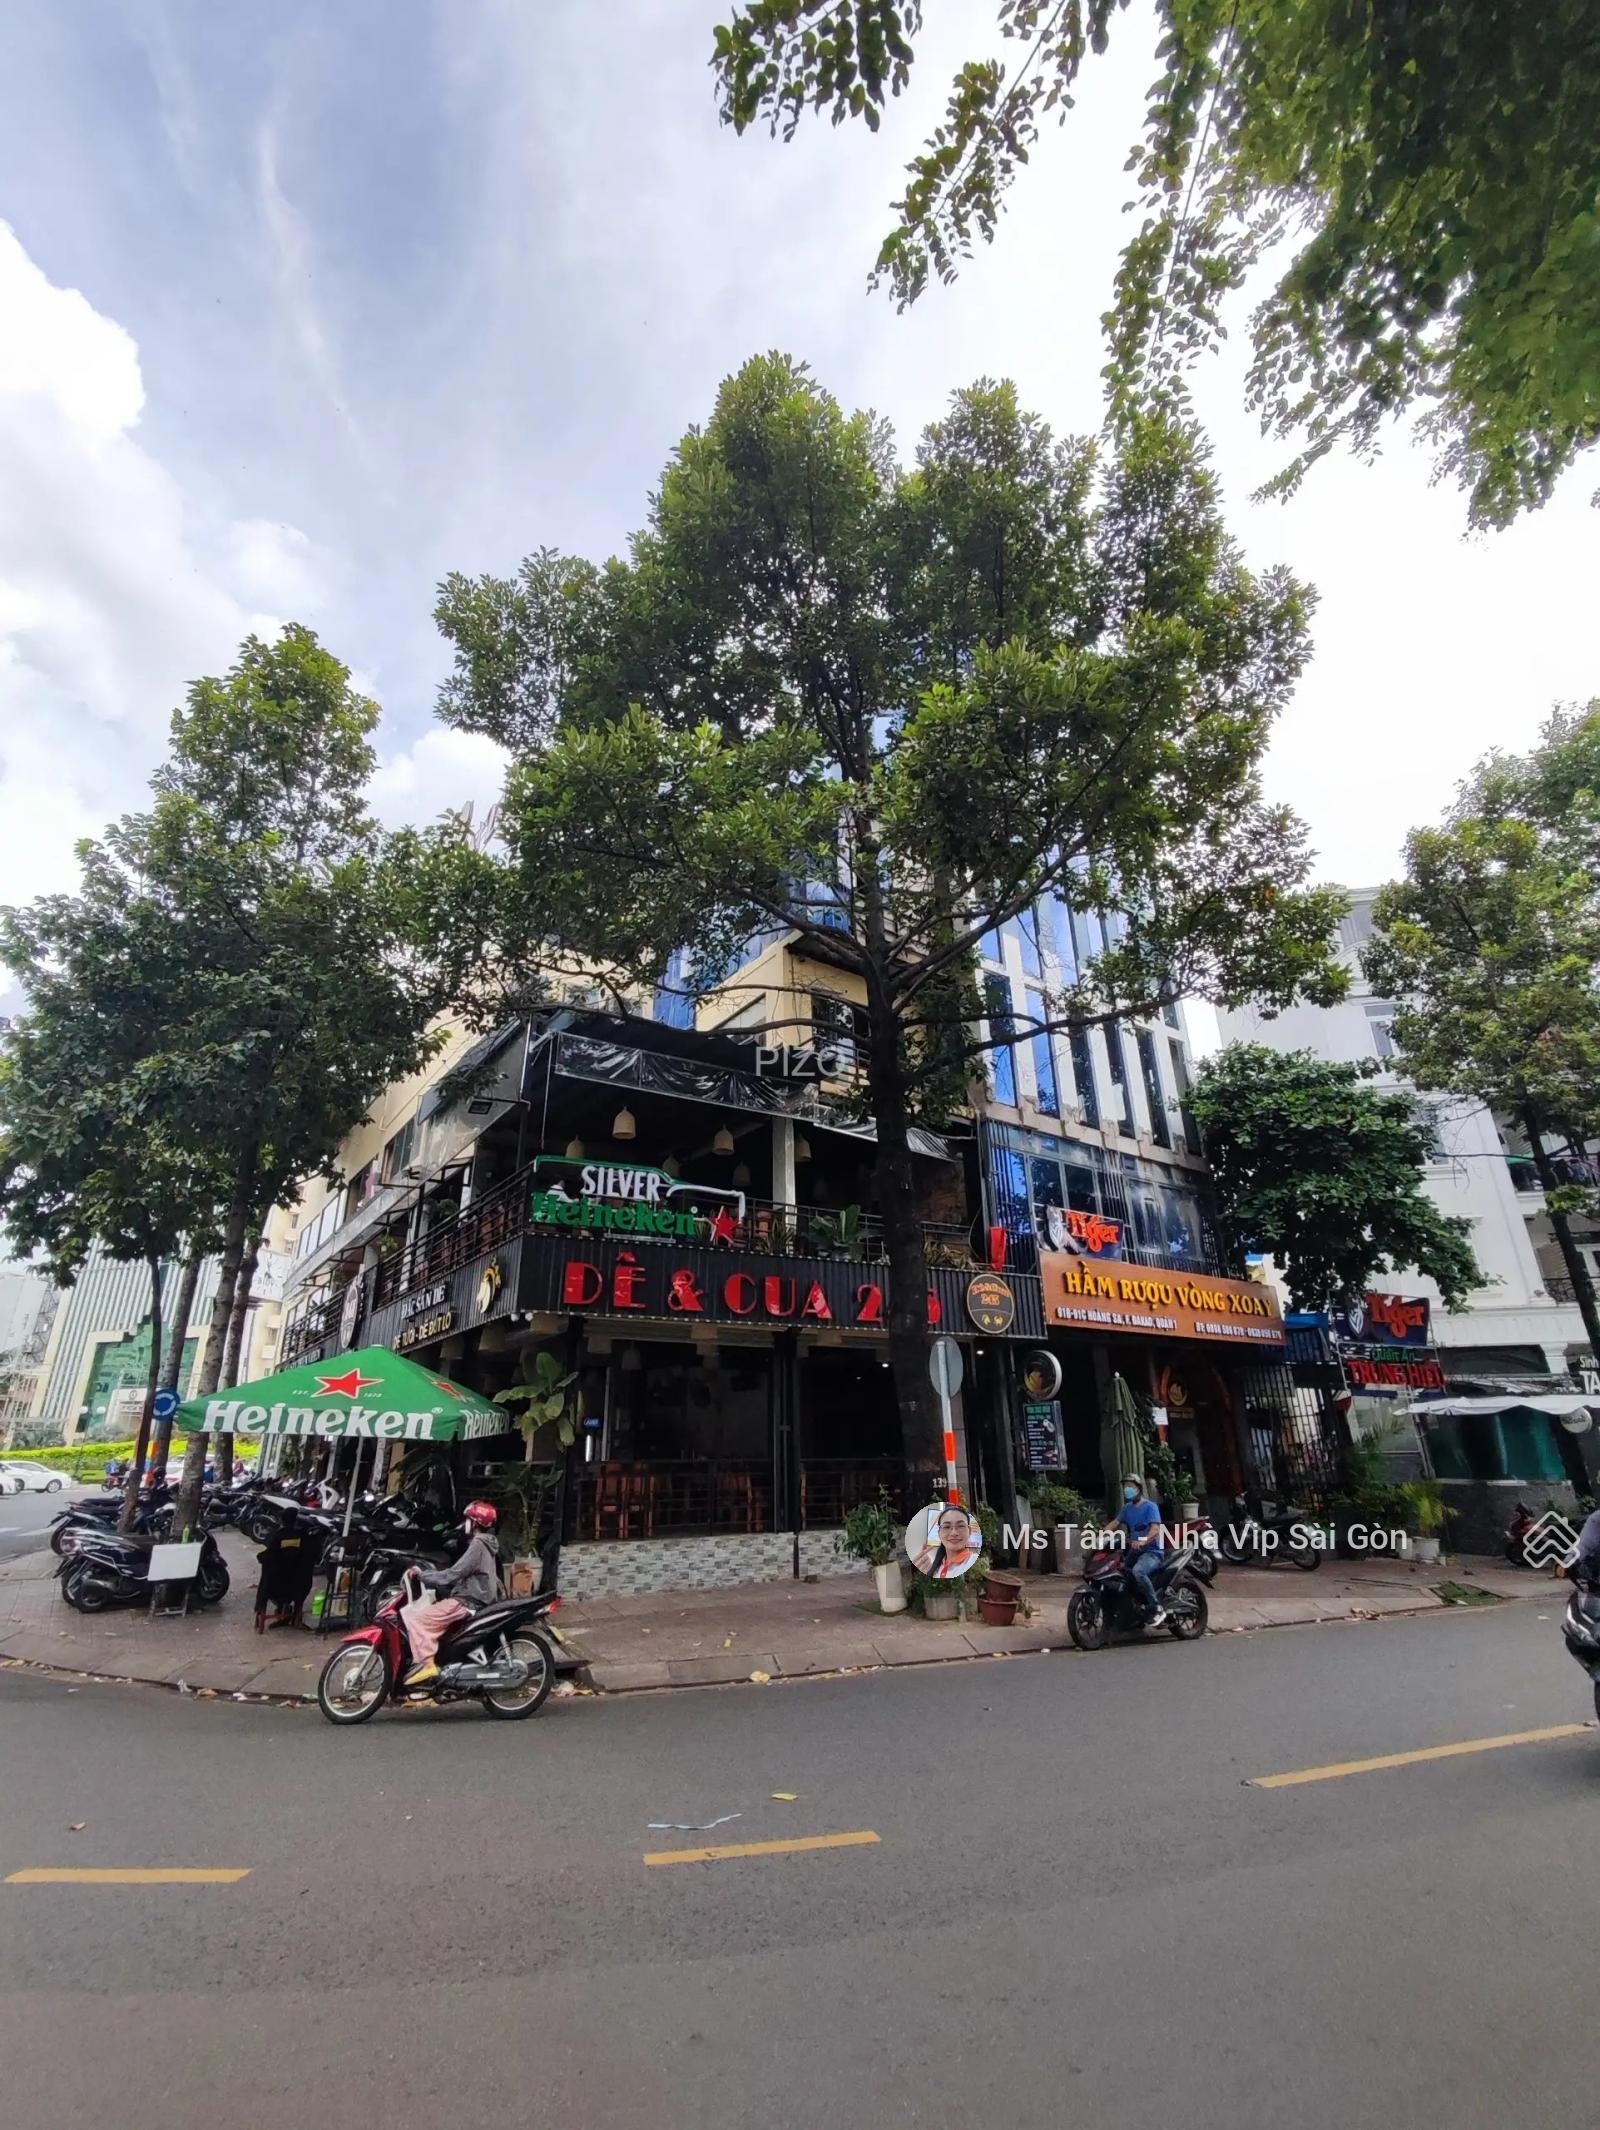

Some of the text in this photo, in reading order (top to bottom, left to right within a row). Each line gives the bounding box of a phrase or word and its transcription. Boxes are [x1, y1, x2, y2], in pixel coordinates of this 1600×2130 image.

[580, 1165, 661, 1201] SILVER
[531, 1192, 698, 1236] Heineken
[1066, 1211, 1119, 1252] Tiger
[563, 1251, 647, 1309] DÊ
[667, 1268, 704, 1312] &
[724, 1272, 833, 1320] CUA
[1064, 1261, 1274, 1317] HẦM RƯỢU VÒNG XOAY
[1366, 1294, 1425, 1338] Tiger
[200, 1400, 434, 1440] Heineken
